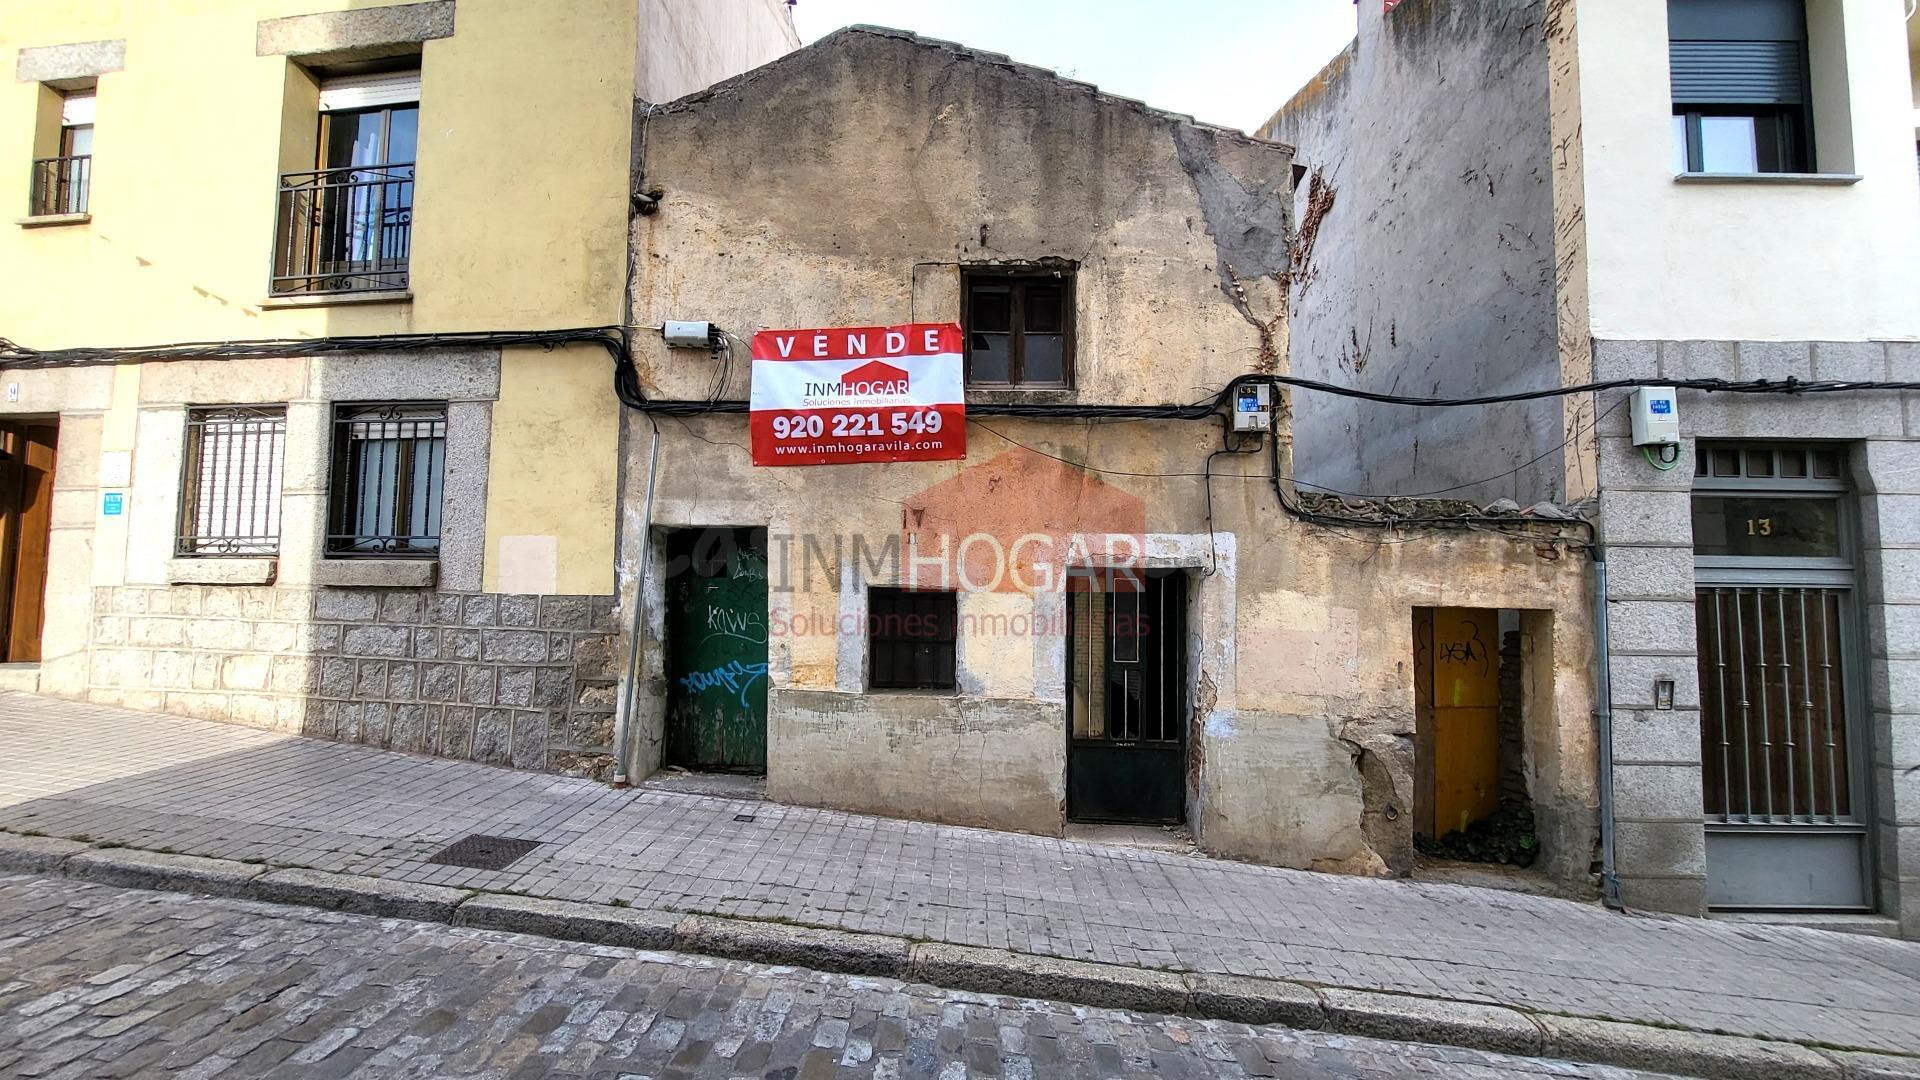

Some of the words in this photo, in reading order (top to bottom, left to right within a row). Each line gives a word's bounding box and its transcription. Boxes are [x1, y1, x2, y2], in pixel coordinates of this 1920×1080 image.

[776, 329, 940, 358] VENDE
[804, 380, 910, 397] INMHOGAR
[803, 398, 851, 407] Soluciones
[773, 416, 824, 439] 920
[831, 412, 885, 437] 221
[891, 411, 942, 435] 549
[775, 440, 943, 455] www.inmhogaravila.com
[1747, 517, 1772, 535] 13
